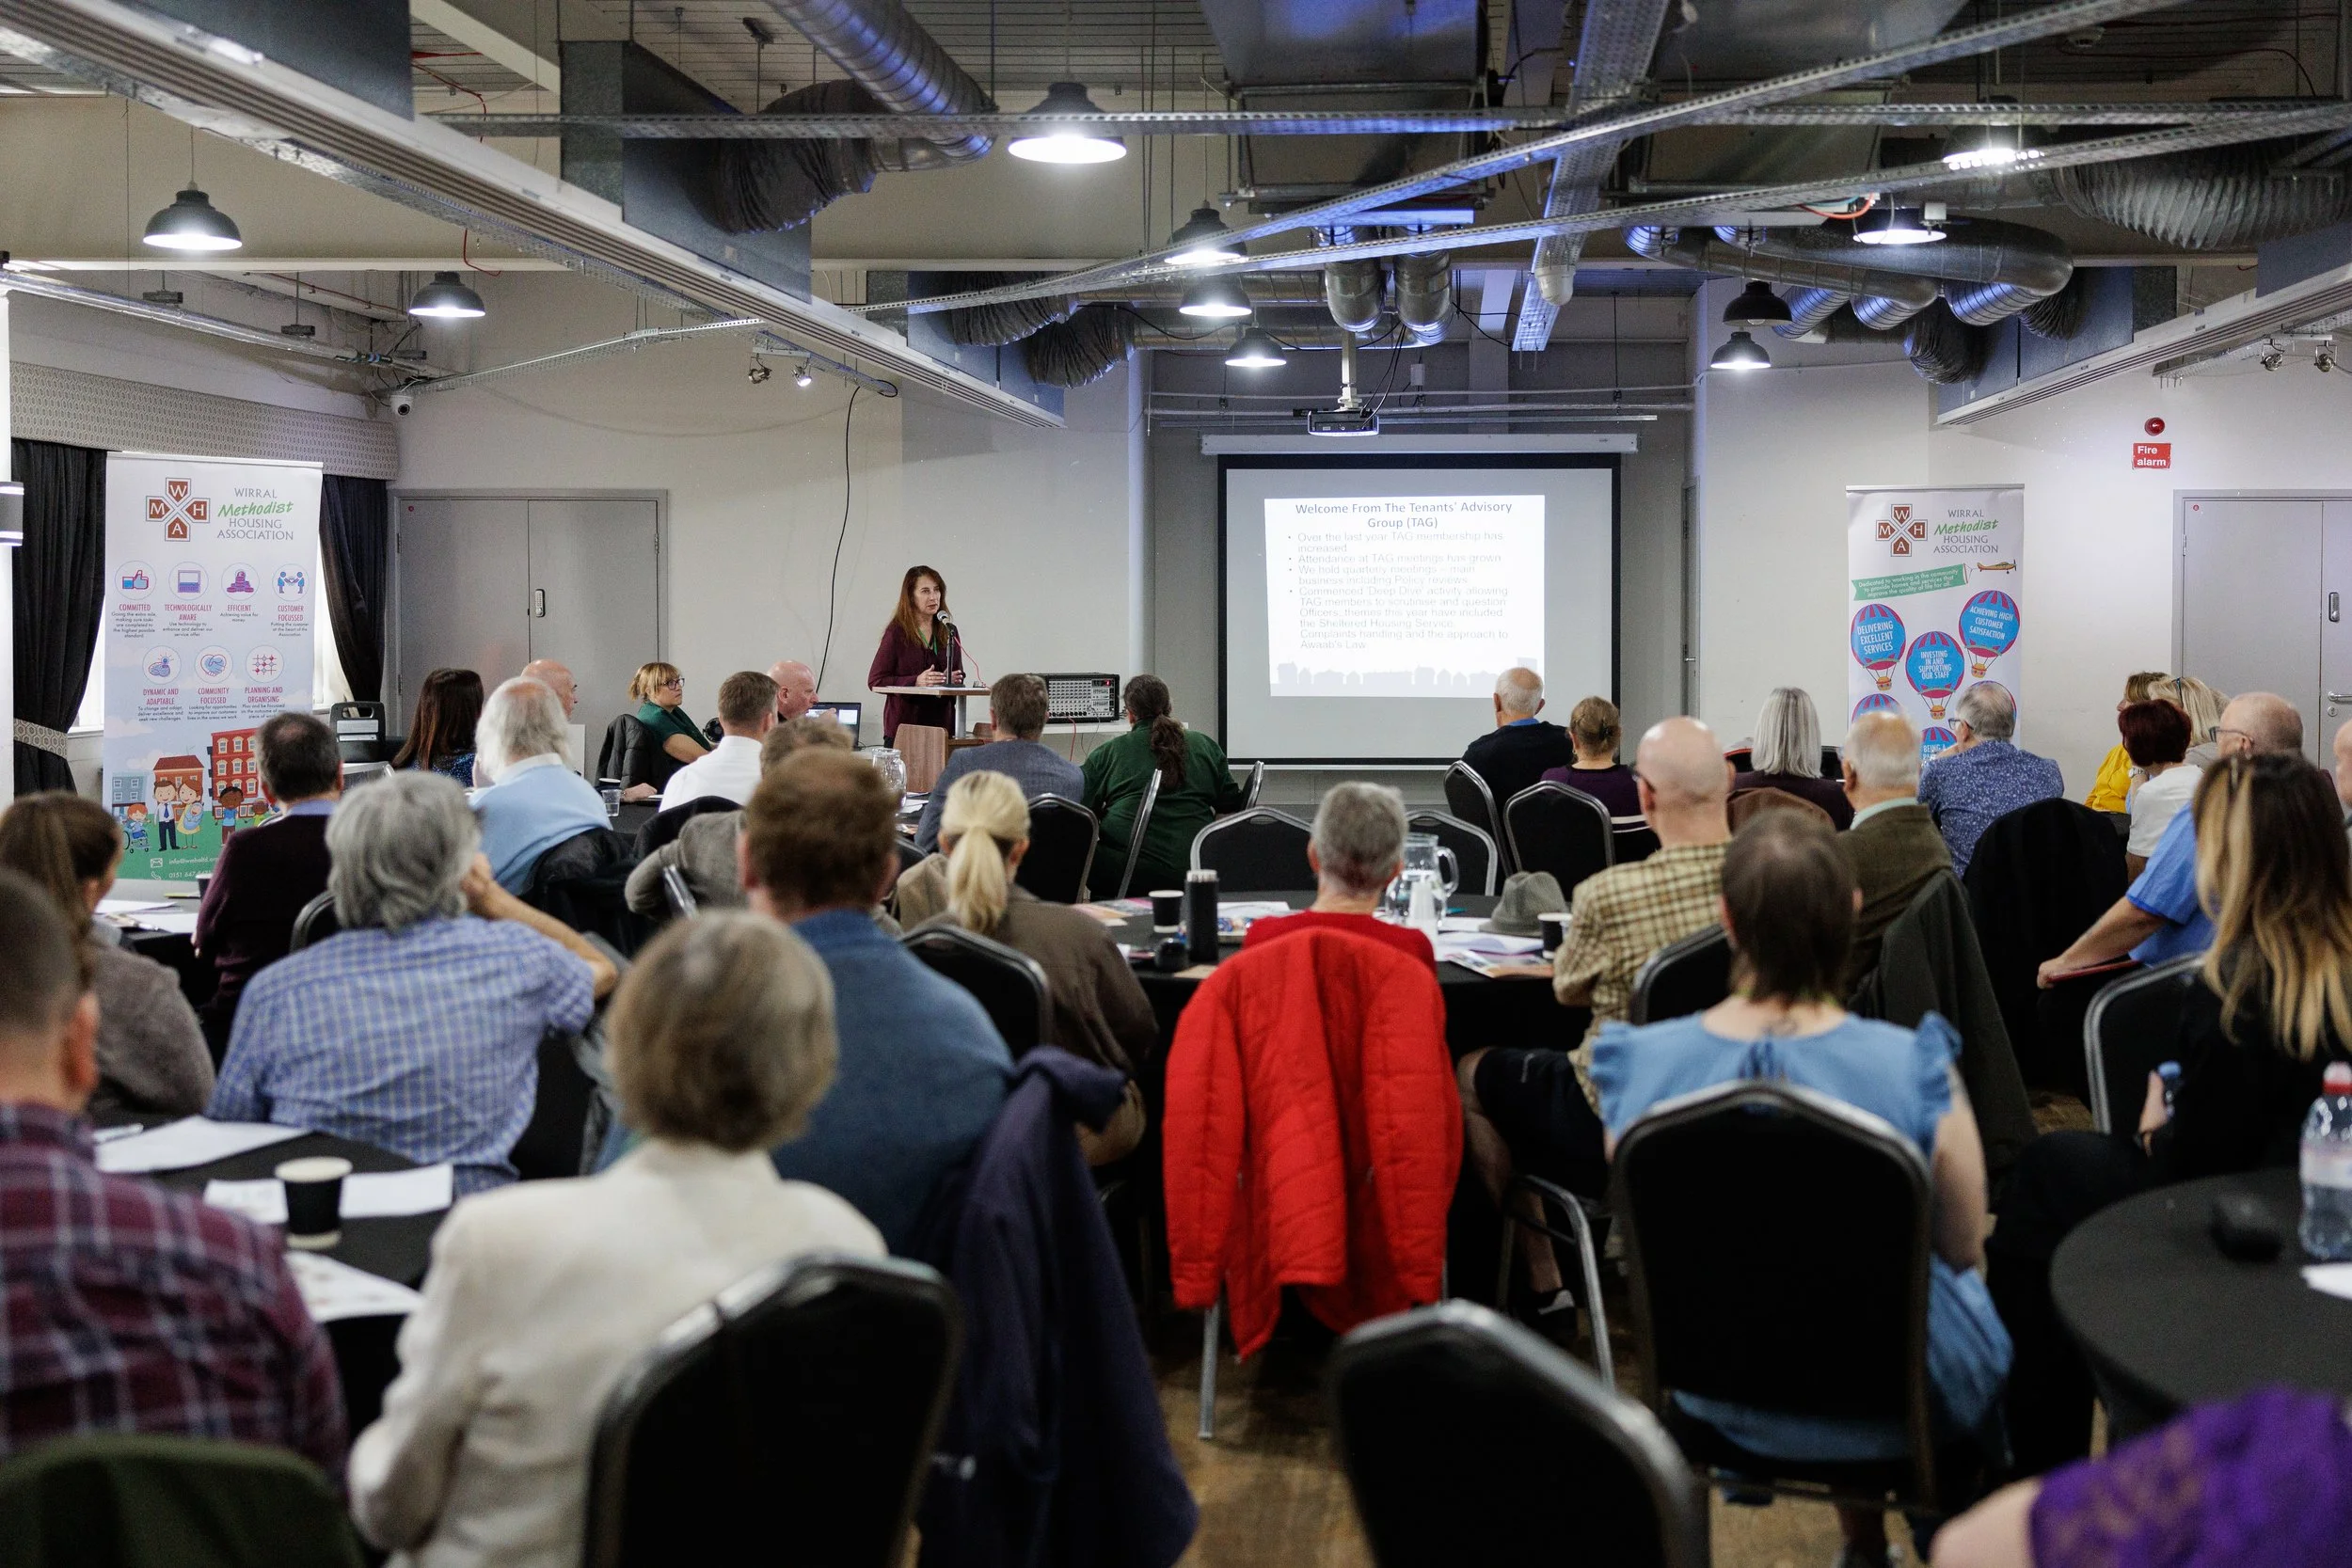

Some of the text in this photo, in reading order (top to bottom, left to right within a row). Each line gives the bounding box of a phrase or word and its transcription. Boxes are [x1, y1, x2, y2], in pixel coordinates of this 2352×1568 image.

[2137, 445, 2158, 454] Fire
[2137, 457, 2167, 467] alarm
[170, 484, 187, 498] W
[234, 487, 278, 499] WIRRAL
[151, 502, 204, 516] M H
[217, 500, 294, 517] Methodist
[1295, 501, 1513, 514] Welcome From The Tenants' Advisory
[1947, 509, 1984, 517] WIRRAL
[1895, 509, 1909, 520] W
[229, 518, 282, 529] HOUSING
[1368, 516, 1438, 529] Group (TAG)
[1933, 519, 1999, 535] Methodist
[171, 523, 183, 535] A
[1879, 525, 1924, 535] M H
[216, 530, 294, 541] ASSOCIATION
[1297, 530, 1503, 543] Over the last year TAG membership has
[1944, 535, 1989, 544] HOUSING
[1298, 543, 1347, 552] increased
[1896, 541, 1907, 551] A
[1933, 545, 1998, 553] ASSOCIATION
[1298, 553, 1502, 564] Attendance at TAG meetings has grown
[1298, 564, 1475, 576] We hold quarterly meetings main
[1298, 575, 1468, 587] business including Policy reviews
[1858, 578, 1884, 588] Dedicated
[1892, 575, 1914, 583] working
[1931, 569, 1959, 578] community
[1299, 586, 1363, 595] Commenced
[1427, 586, 1461, 596] activity
[1467, 585, 1508, 597] allowing
[1871, 584, 1890, 594] provide
[1899, 585, 1916, 594] quality
[1300, 596, 1506, 608] TAG members to scrutinise and question
[1385, 608, 1403, 617] this
[1406, 609, 1428, 619] year
[1431, 608, 1456, 617] have
[1459, 608, 1503, 617] included
[1970, 606, 2013, 622] ACHIEVING HIGH
[1300, 618, 1315, 627] the
[1319, 618, 1367, 628] Sheltered
[1370, 618, 1412, 630] Housing
[1857, 621, 1894, 635] DELIVERING
[1975, 617, 2004, 629] CUSTOMER
[1300, 628, 1509, 641] Complaints handling and the approach to
[1860, 631, 1894, 645] EXCELLENT
[1969, 626, 2005, 641] SATISFACTION
[1300, 640, 1366, 649] Awaab's Law
[1863, 641, 1894, 656] SERVICES
[1920, 650, 1947, 658] INVESTING
[1918, 664, 1952, 673] SUPPORTING
[1921, 672, 1933, 680] OUR
[143, 688, 167, 696] DYNAMIC
[200, 696, 227, 705] FOCUSSED
[247, 695, 280, 704] ORGANISING
